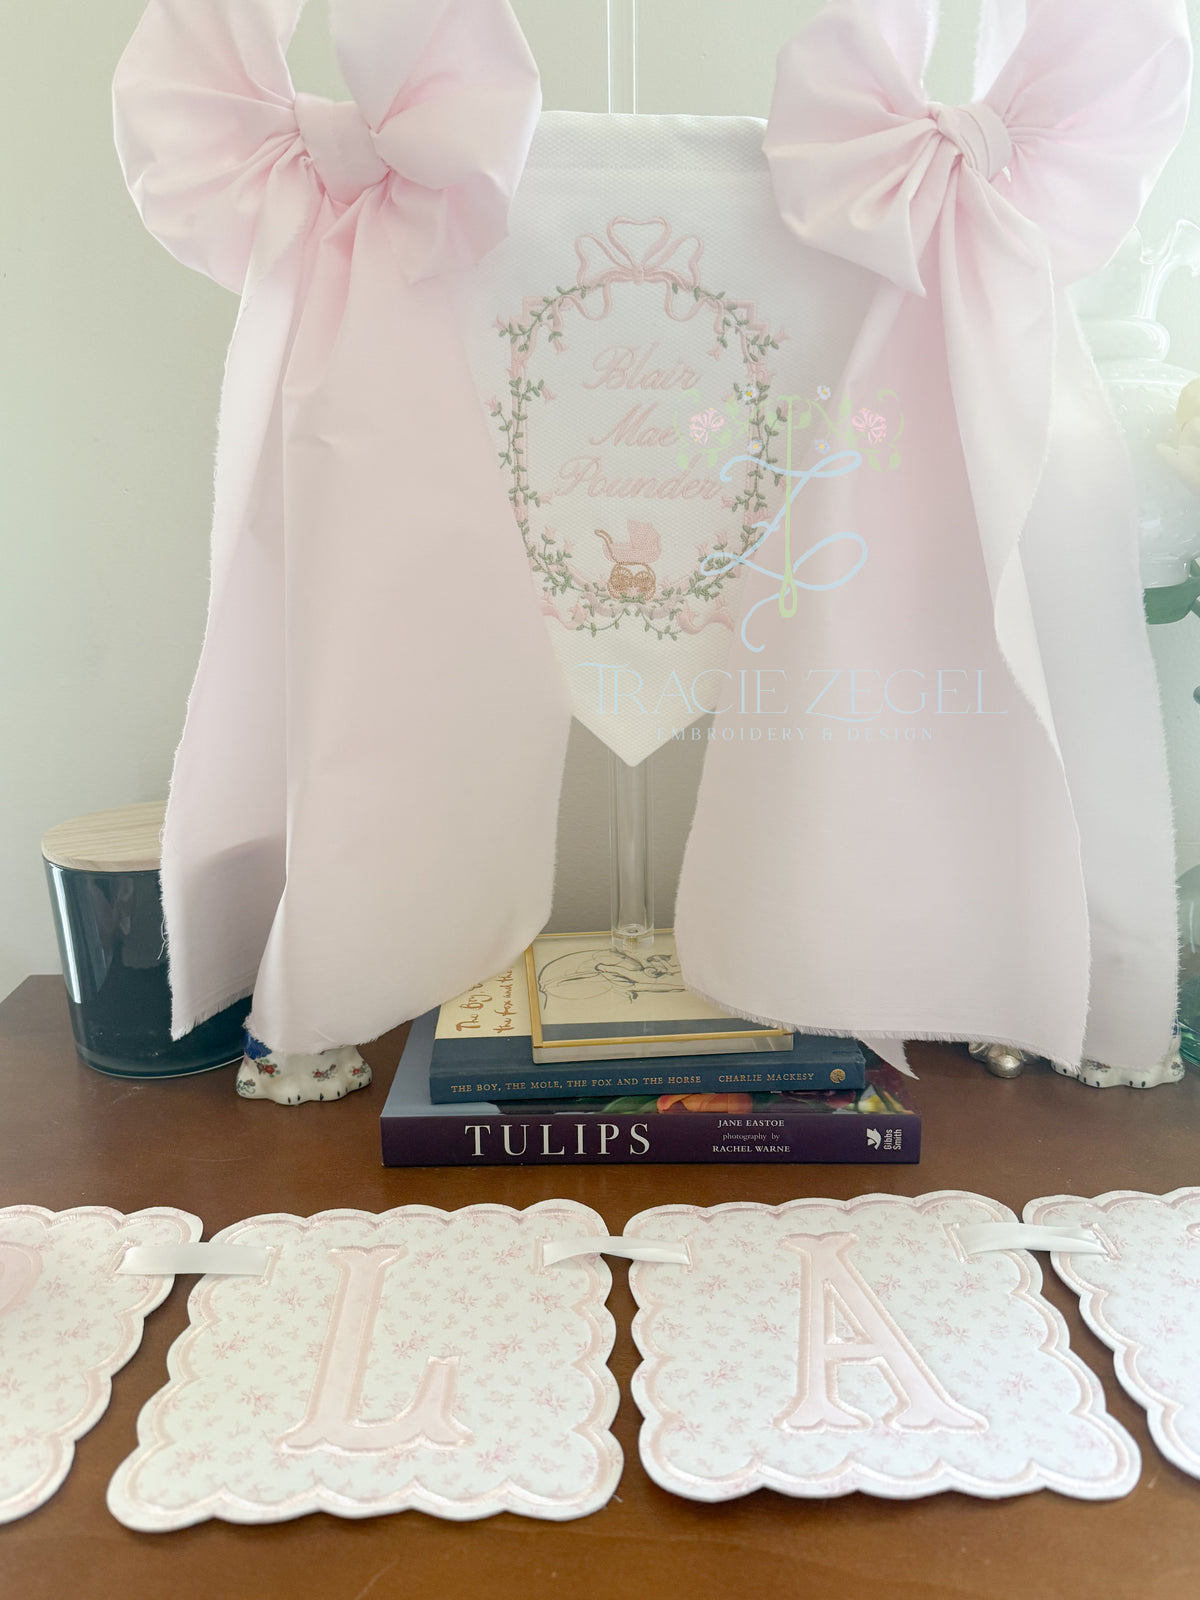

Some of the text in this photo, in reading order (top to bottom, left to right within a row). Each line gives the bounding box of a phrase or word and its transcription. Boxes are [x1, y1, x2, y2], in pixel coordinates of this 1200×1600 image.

[582, 341, 702, 391] Blair
[588, 401, 683, 448] Mae
[553, 453, 722, 500] Pounder
[451, 1072, 815, 1094] THE BOY, THE MOLE, THE FOX AND THE HORSE CHARLIE MACKESY
[717, 1119, 785, 1128] JANE EASTOE
[464, 1122, 651, 1157] TULIPS
[722, 1132, 780, 1141] photography by
[883, 1128, 893, 1150] Gibbs
[892, 1128, 903, 1150] Smith
[712, 1145, 791, 1153] RACHEL WARNE
